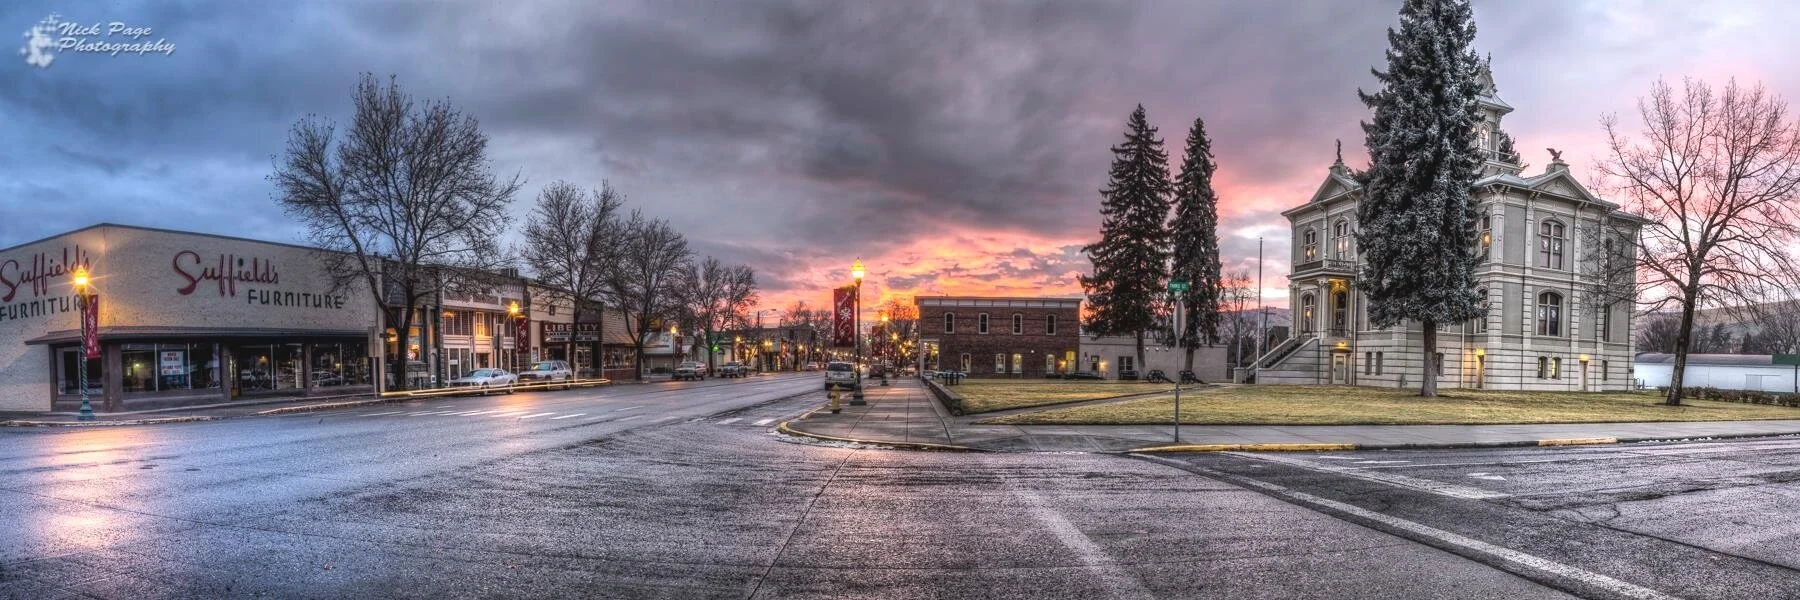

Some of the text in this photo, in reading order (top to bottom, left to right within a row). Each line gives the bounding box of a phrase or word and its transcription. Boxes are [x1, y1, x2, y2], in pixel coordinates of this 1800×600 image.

[0, 244, 91, 302] Suffield's
[172, 250, 279, 297] Suffield's
[0, 294, 85, 321] FURNITUR
[248, 289, 344, 309] FURNITURE
